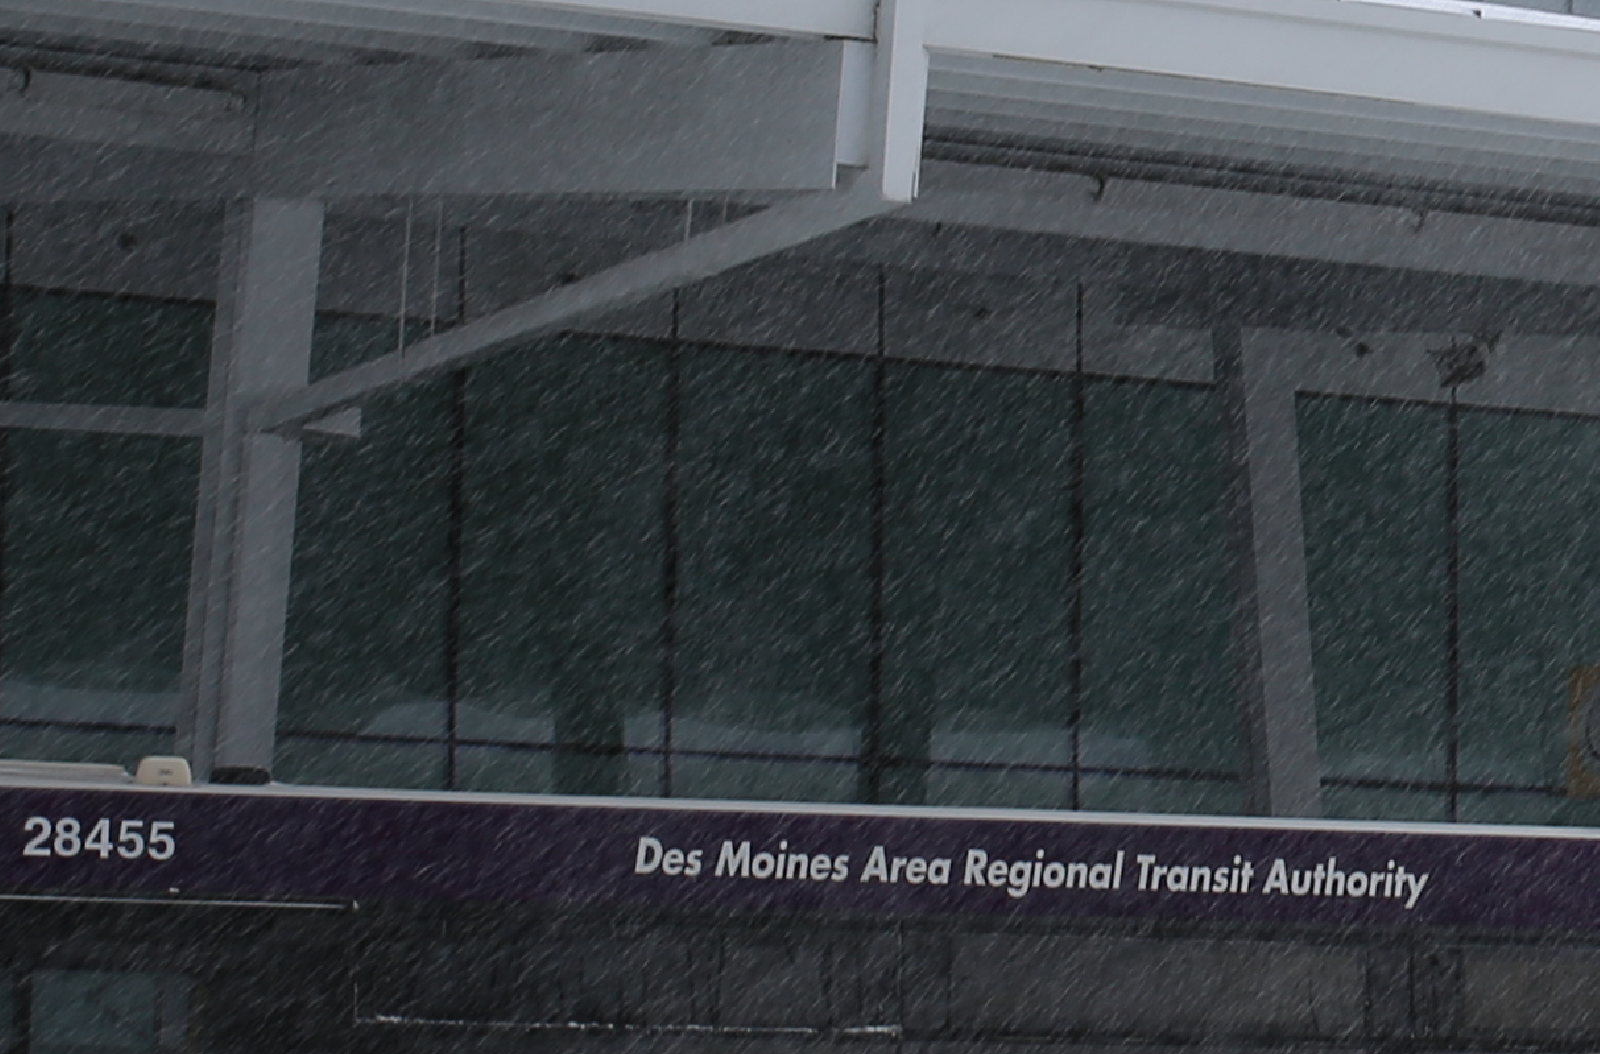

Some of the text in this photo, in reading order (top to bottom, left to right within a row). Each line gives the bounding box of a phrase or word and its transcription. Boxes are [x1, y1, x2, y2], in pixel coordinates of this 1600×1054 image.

[22, 816, 176, 860] 28455
[634, 836, 1429, 909] Des Moines Area Regional Transit Authority
